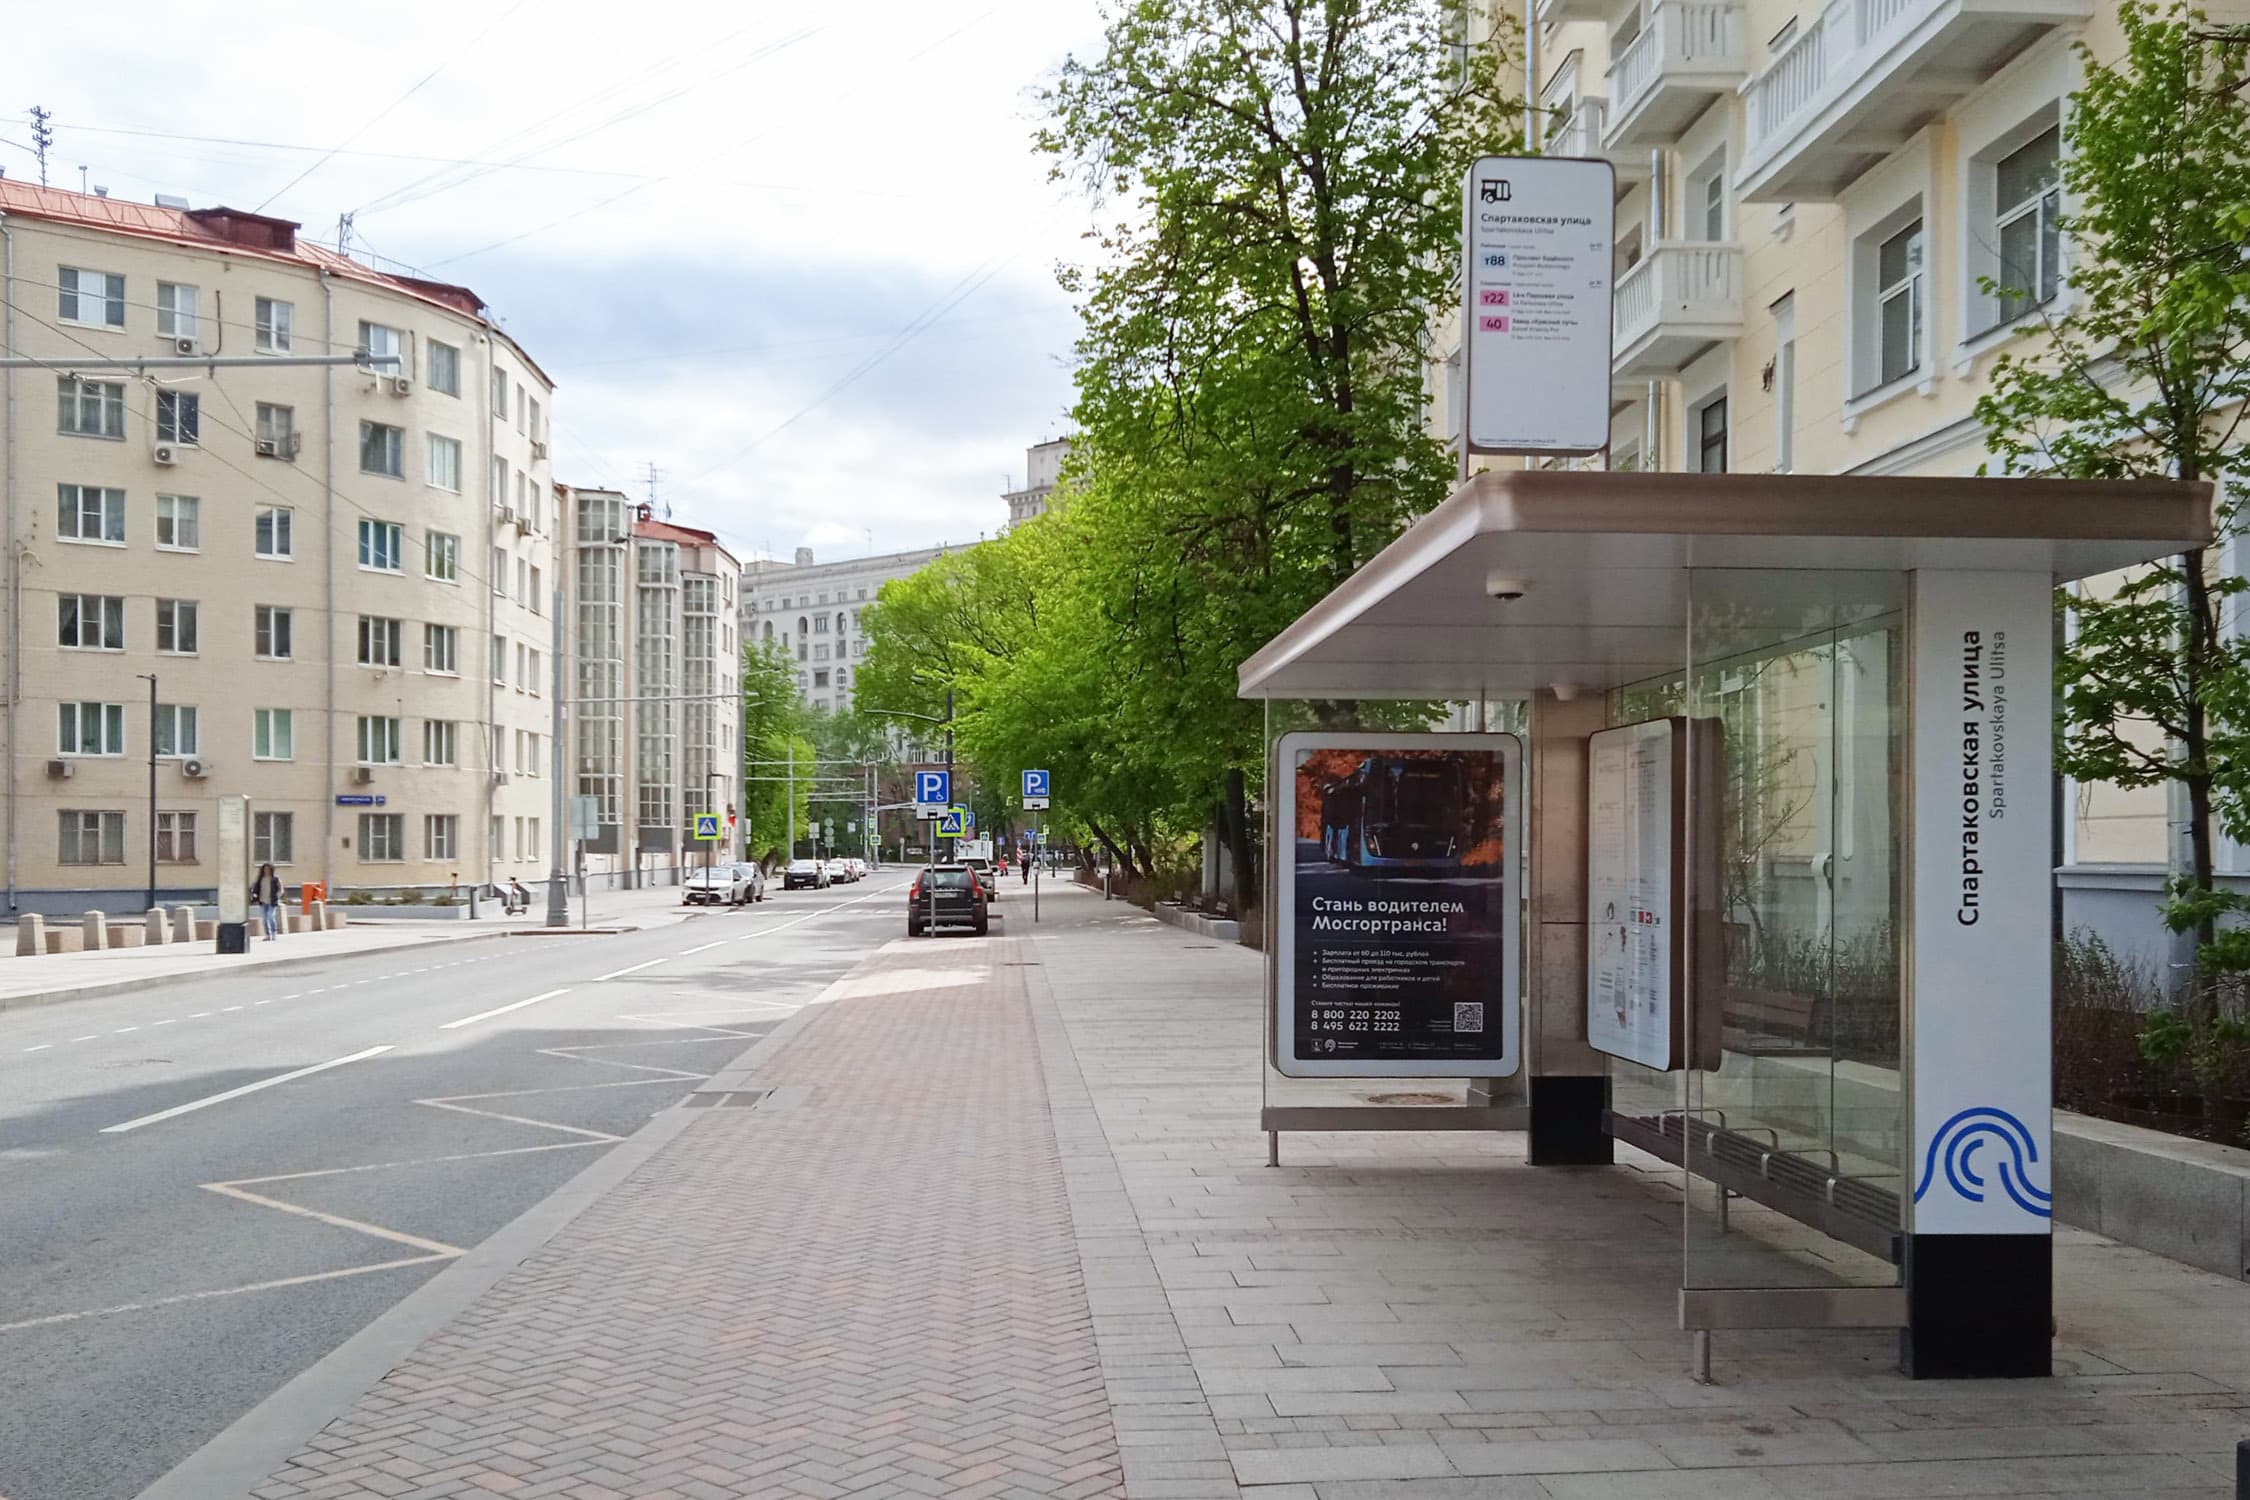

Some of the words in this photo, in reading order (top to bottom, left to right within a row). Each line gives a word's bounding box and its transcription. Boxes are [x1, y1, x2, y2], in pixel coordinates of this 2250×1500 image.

[1480, 212, 1559, 225] Спартаковская
[1560, 216, 1592, 227] улица
[1484, 255, 1506, 266] т88
[1484, 292, 1505, 304] т22
[1486, 318, 1503, 331] 40
[1989, 631, 2006, 680] Ulitsa
[1963, 630, 1985, 712] улица
[1989, 685, 2008, 819] Spartakovskaya
[924, 774, 942, 801] P
[1027, 773, 1041, 794] P
[1958, 721, 1984, 926] Спартаковская
[1312, 896, 1363, 912] Стань
[1367, 900, 1465, 915] водителем
[1312, 915, 1448, 934] Мосгортранса!
[1311, 1009, 1319, 1019] 8
[1323, 1009, 1345, 1020] 800
[1349, 1010, 1370, 1020] 220
[1374, 1010, 1401, 1020] 2202
[1311, 1021, 1318, 1031] 8
[1323, 1021, 1344, 1031] 495
[1348, 1021, 1369, 1031] 622
[1373, 1022, 1400, 1032] 2222
